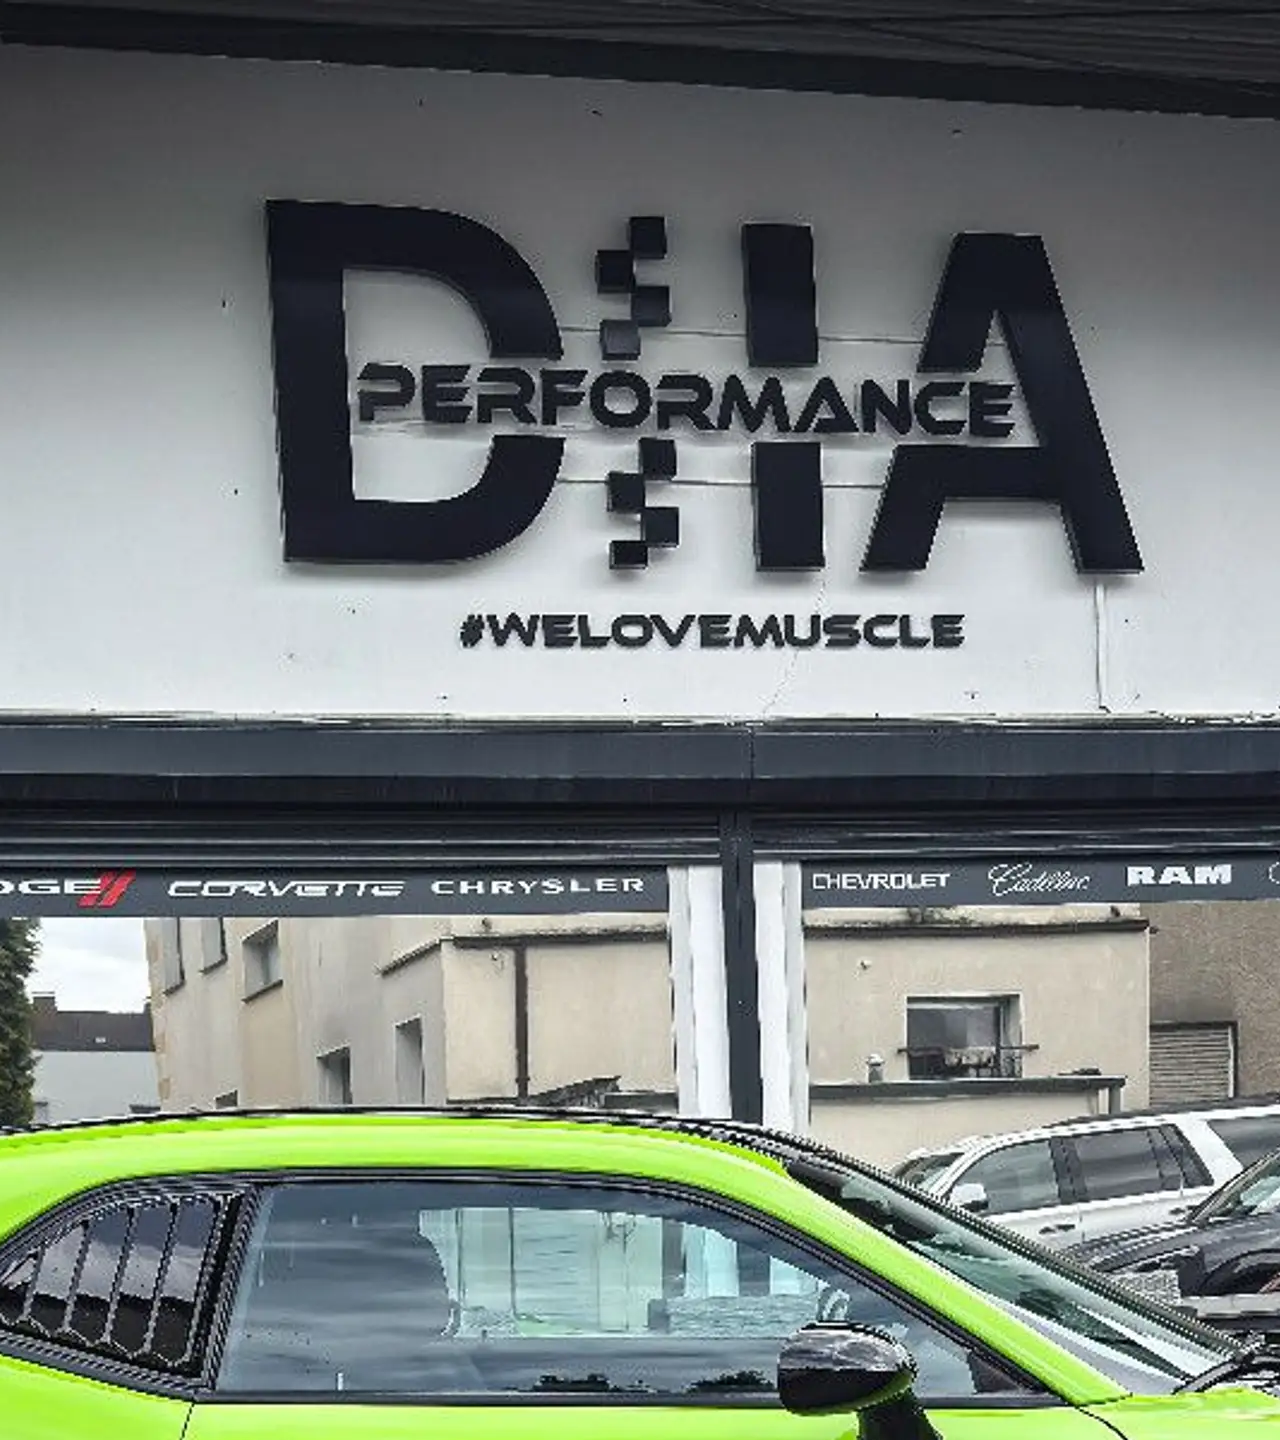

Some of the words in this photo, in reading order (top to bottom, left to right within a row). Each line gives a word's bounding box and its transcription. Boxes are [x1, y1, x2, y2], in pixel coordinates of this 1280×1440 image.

[357, 363, 1016, 437] PERFORMANCE
[459, 613, 965, 650] #WELOVEMUSCLE
[168, 880, 406, 899] CORVETTE
[430, 877, 646, 896] CHRYSLER
[812, 872, 951, 890] CHEVROLET
[986, 861, 1092, 897] Cadillac
[1126, 864, 1233, 887] RAM
